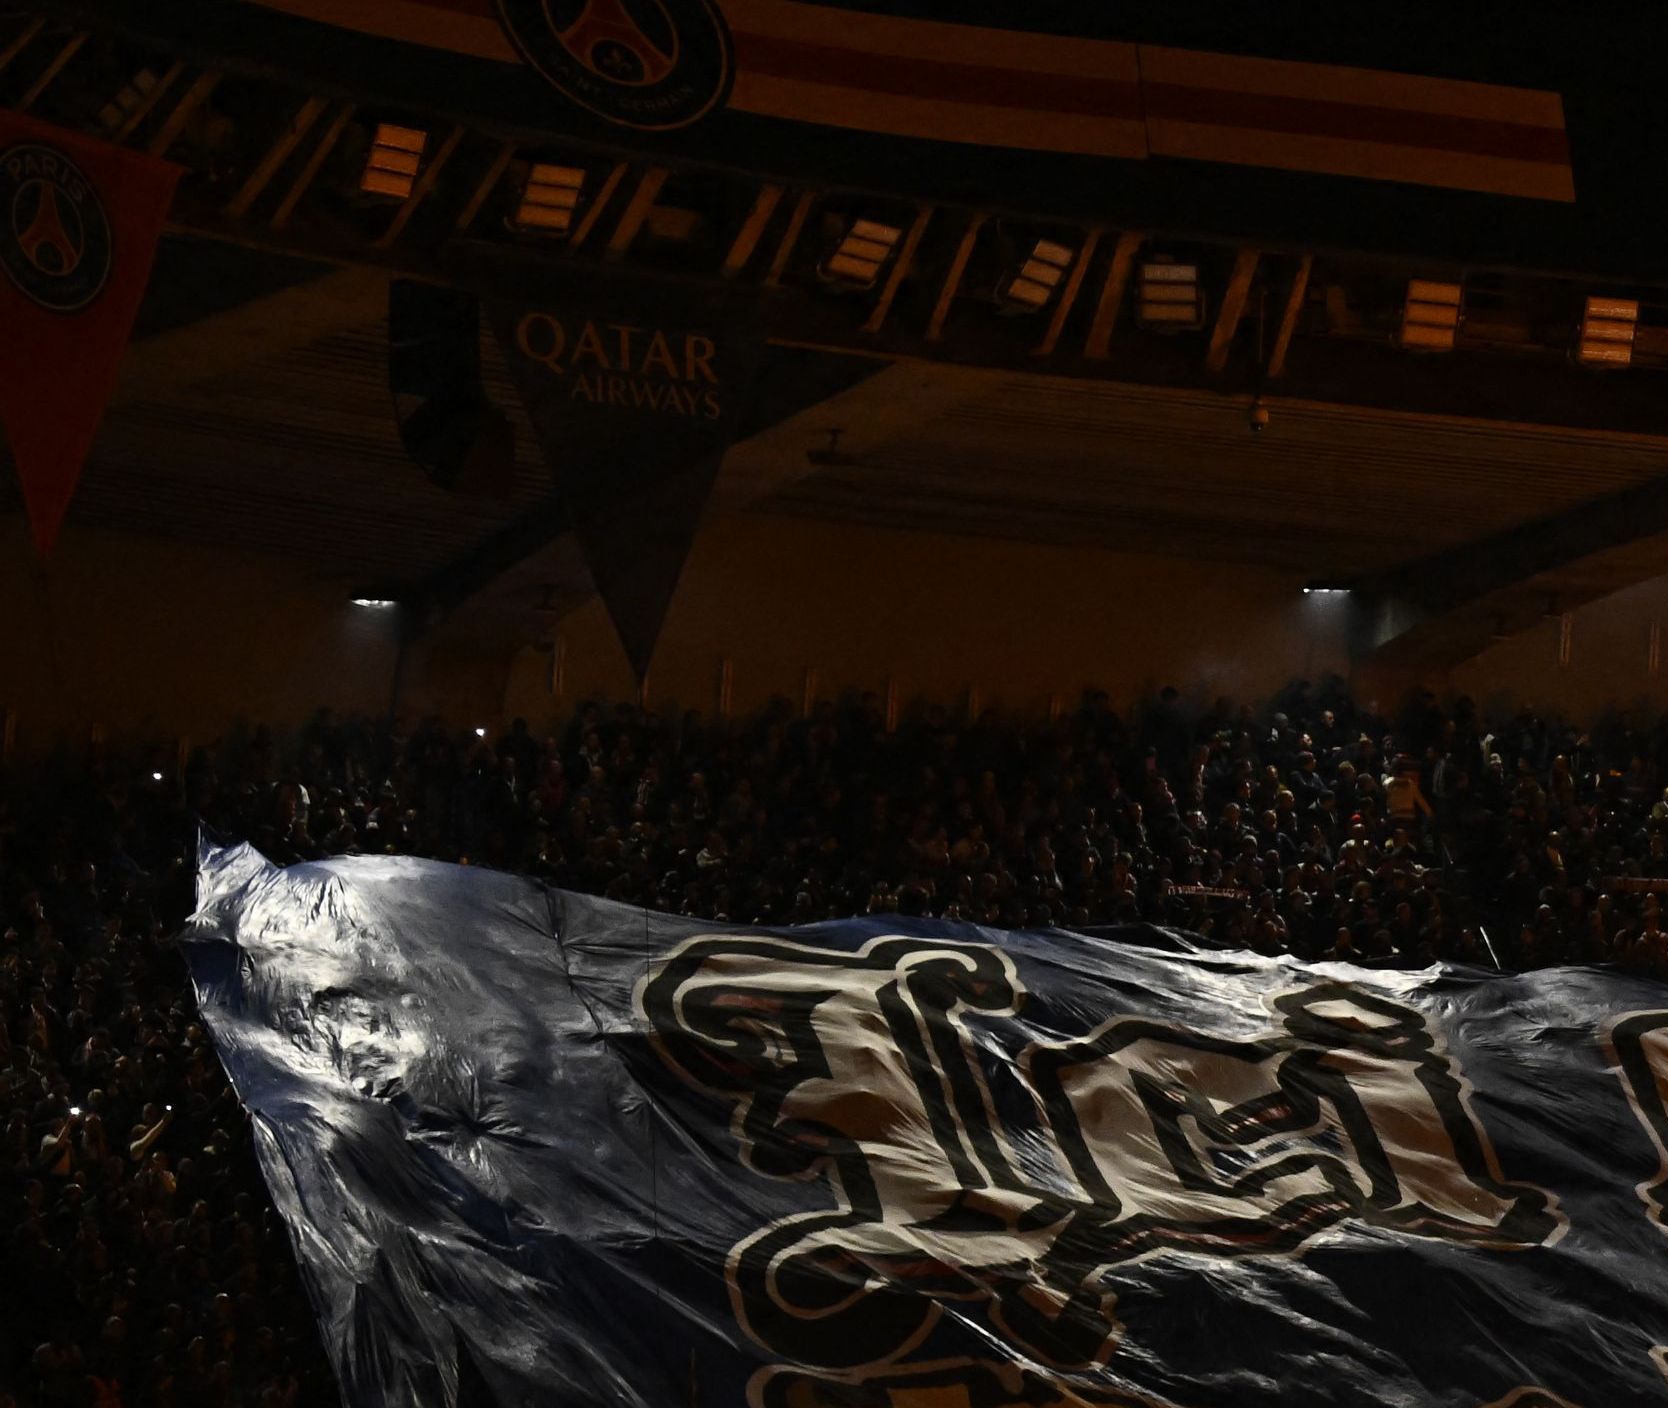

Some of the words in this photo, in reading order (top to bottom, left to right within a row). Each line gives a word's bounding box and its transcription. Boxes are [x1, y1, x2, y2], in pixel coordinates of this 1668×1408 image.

[7, 152, 89, 203] PARIS
[515, 310, 720, 385] QATAR
[570, 371, 722, 421] AIRWAYS
[634, 934, 1570, 1370] Ici
